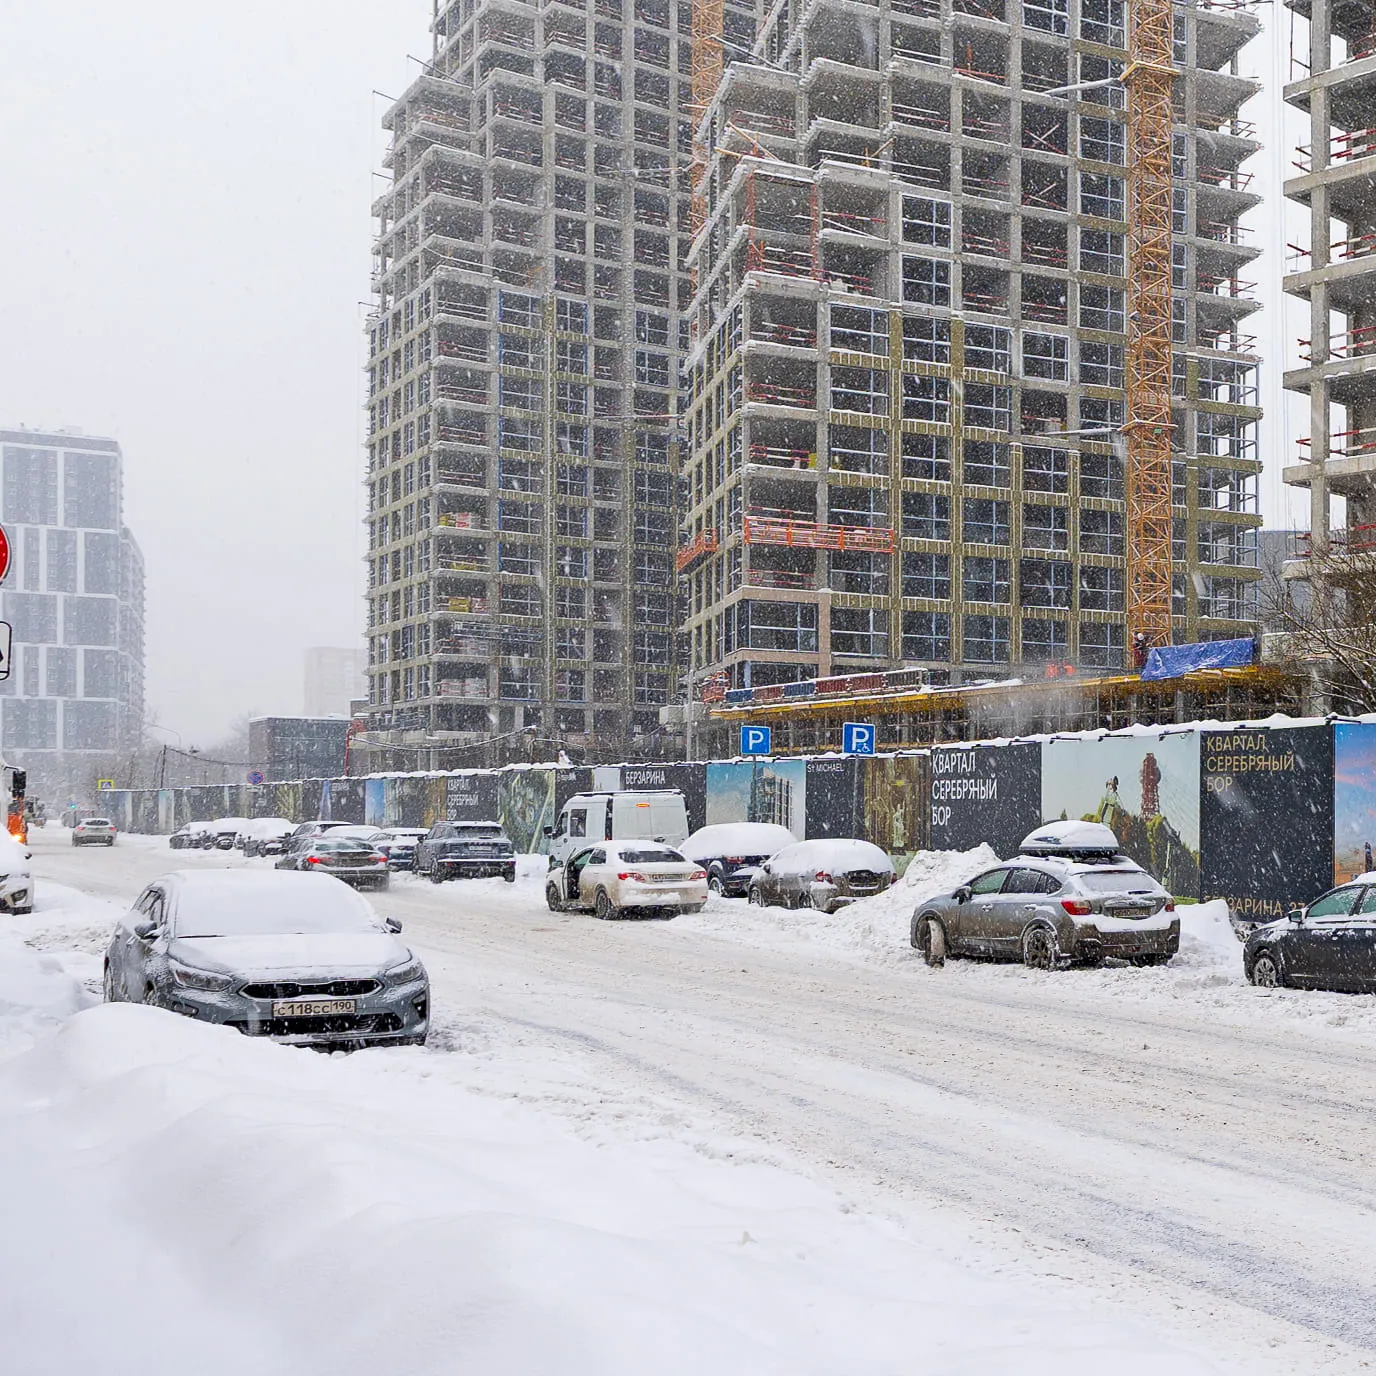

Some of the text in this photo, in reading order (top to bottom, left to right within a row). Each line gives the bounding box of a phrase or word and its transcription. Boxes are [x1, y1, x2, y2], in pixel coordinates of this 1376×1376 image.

[748, 730, 764, 750] P
[851, 727, 869, 751] P
[1206, 734, 1266, 752] КВАРТАЛ
[816, 762, 845, 772] MICHAEL
[932, 752, 976, 774] КВАРТАЛ
[1206, 751, 1294, 772] СЕРЕБРЯНЫЙ
[625, 770, 666, 784] БЕРЗАРИНА
[932, 773, 998, 800] СЕРЕБРЯНЫЙ
[1206, 776, 1233, 792] БОР
[932, 806, 952, 826] БОР
[1203, 895, 1284, 916] ЗАРИНА
[333, 1001, 352, 1010] 190
